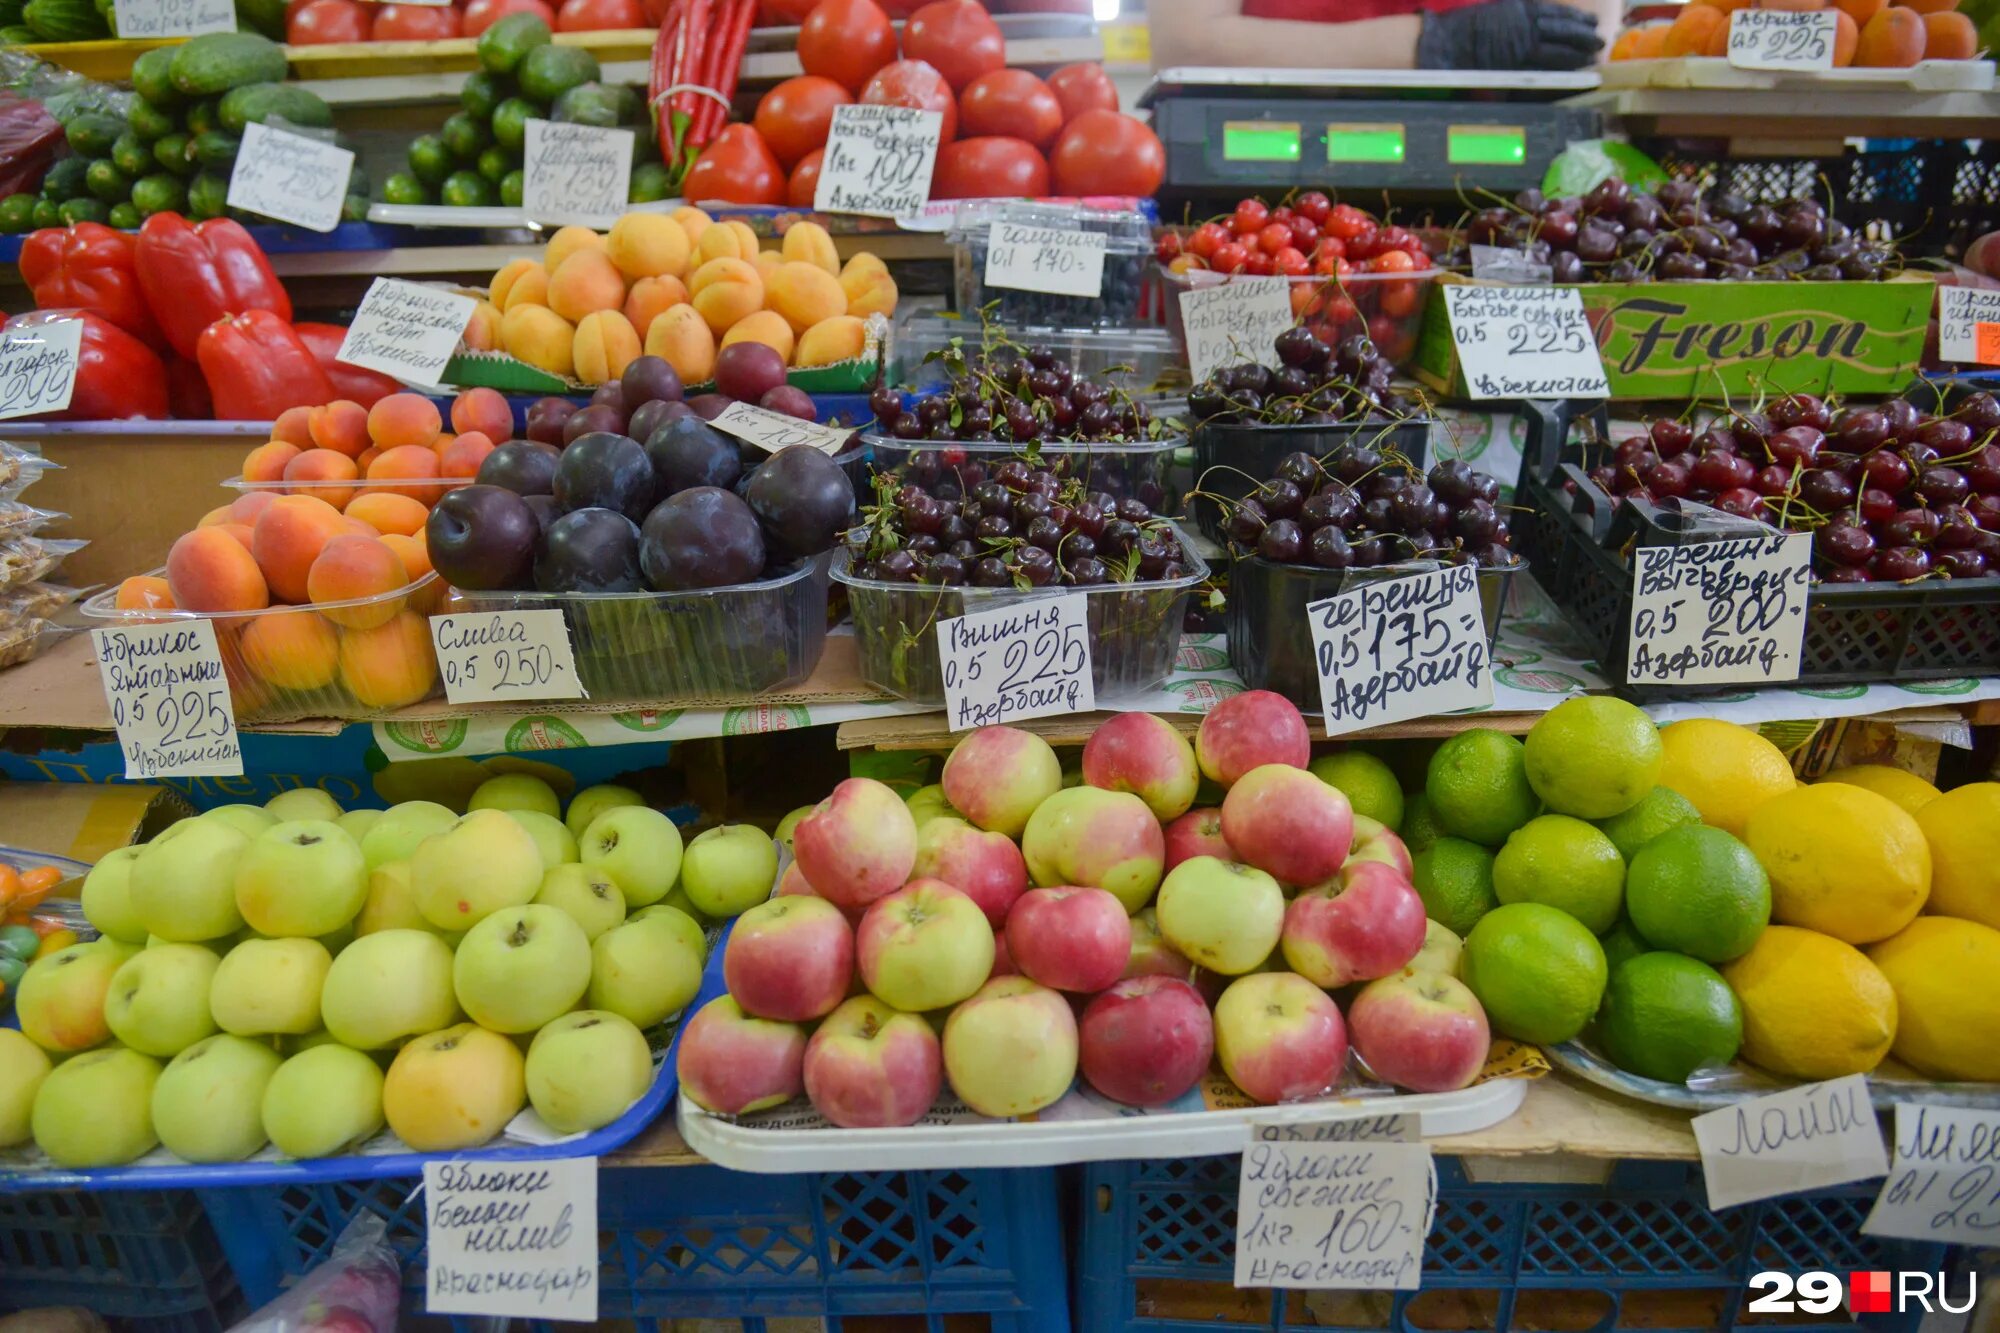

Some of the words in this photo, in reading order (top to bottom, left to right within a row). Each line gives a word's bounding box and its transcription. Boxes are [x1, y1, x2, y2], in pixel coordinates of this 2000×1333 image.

[1762, 27, 1834, 61] 225
[1597, 297, 1869, 375] Freson
[1474, 373, 1608, 397] Узбекистан
[438, 615, 527, 650] Слива
[951, 605, 1060, 653] Вишня
[1634, 599, 1687, 639] 0,5
[100, 630, 200, 671] Абрикос
[945, 650, 987, 689] 0,5
[997, 623, 1086, 694] 225
[1318, 626, 1362, 677] 0,5
[446, 655, 479, 688] 0,5
[1330, 640, 1484, 721] Азербайд
[113, 692, 149, 727] 0,5
[1719, 1083, 1866, 1156] Лайм
[436, 1161, 552, 1195] Яблоки
[464, 1202, 574, 1253] налив
[1243, 1211, 1294, 1250] 1кг
